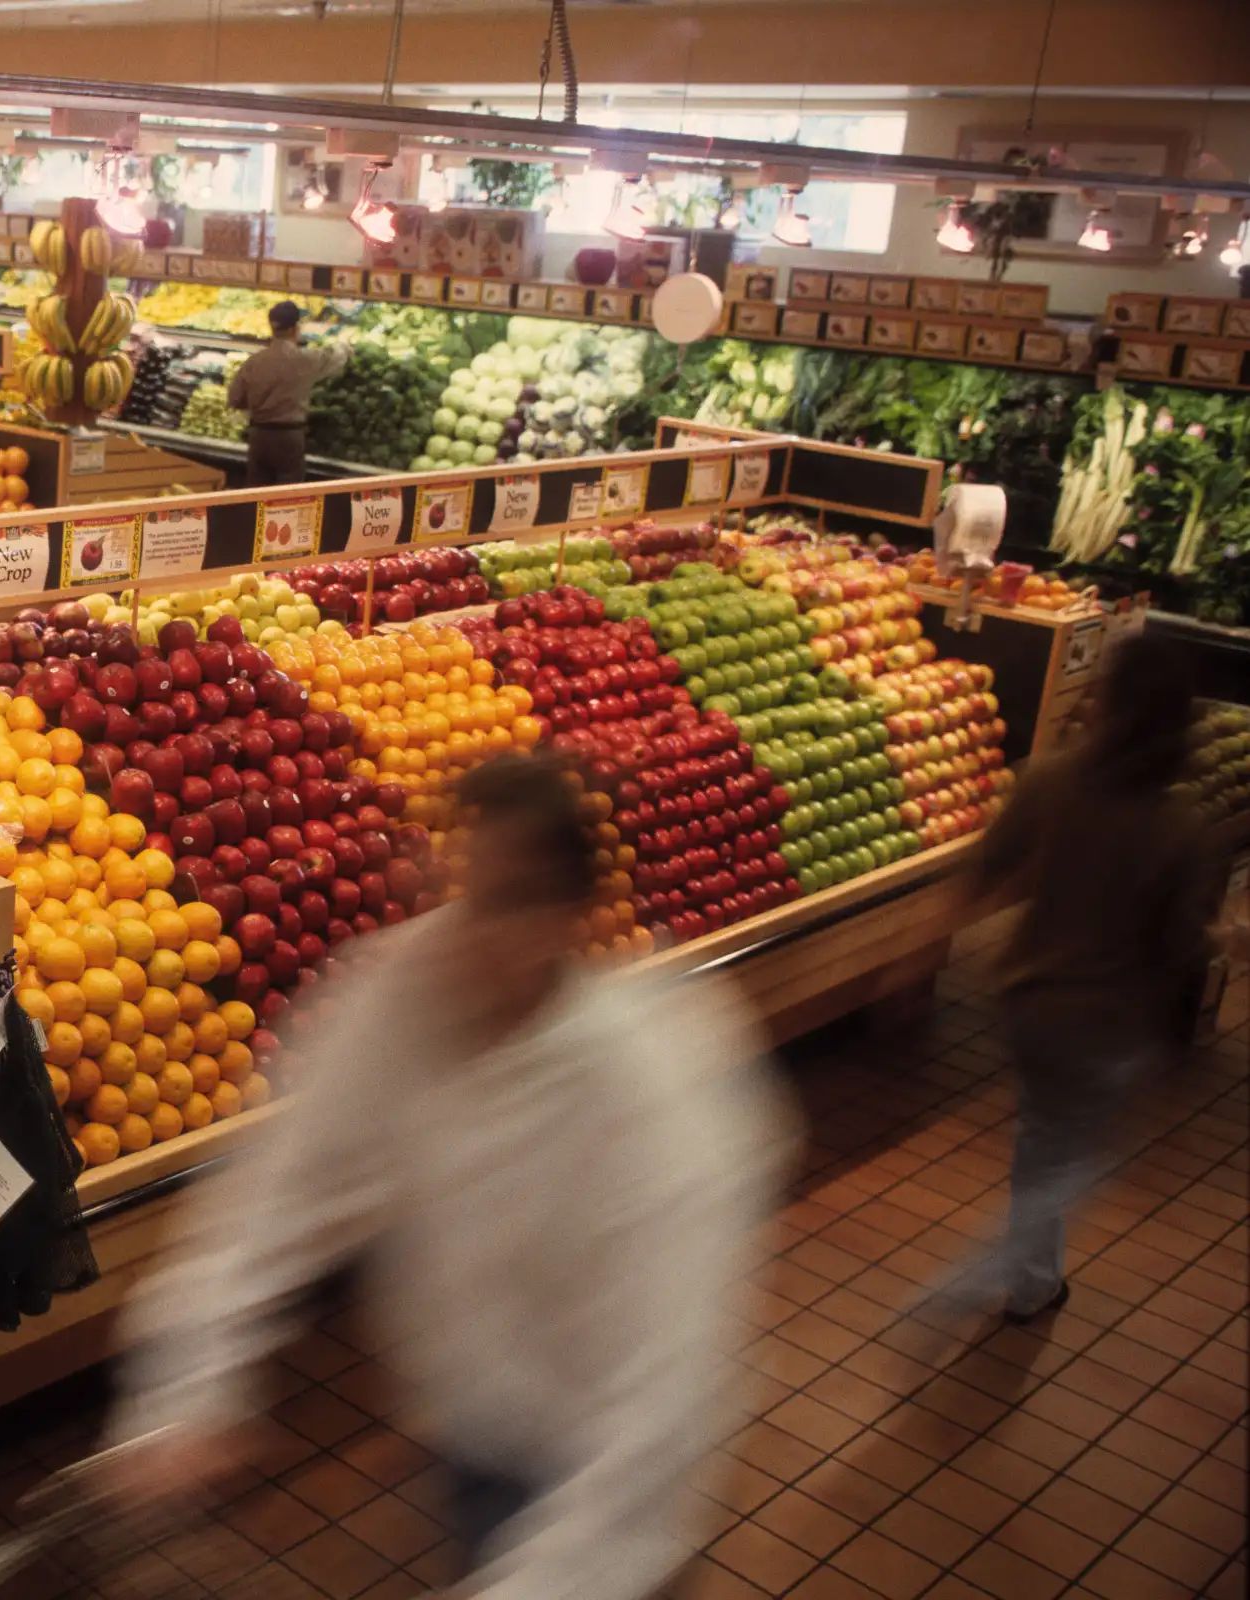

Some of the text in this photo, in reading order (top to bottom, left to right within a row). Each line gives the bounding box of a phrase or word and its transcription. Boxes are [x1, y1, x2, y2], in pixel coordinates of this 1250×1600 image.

[506, 490, 530, 504] New
[364, 505, 391, 520] New
[503, 506, 528, 520] Crop
[362, 523, 390, 537] Crop
[62, 520, 73, 588] ORGANIC
[131, 514, 141, 580] ORGANIC
